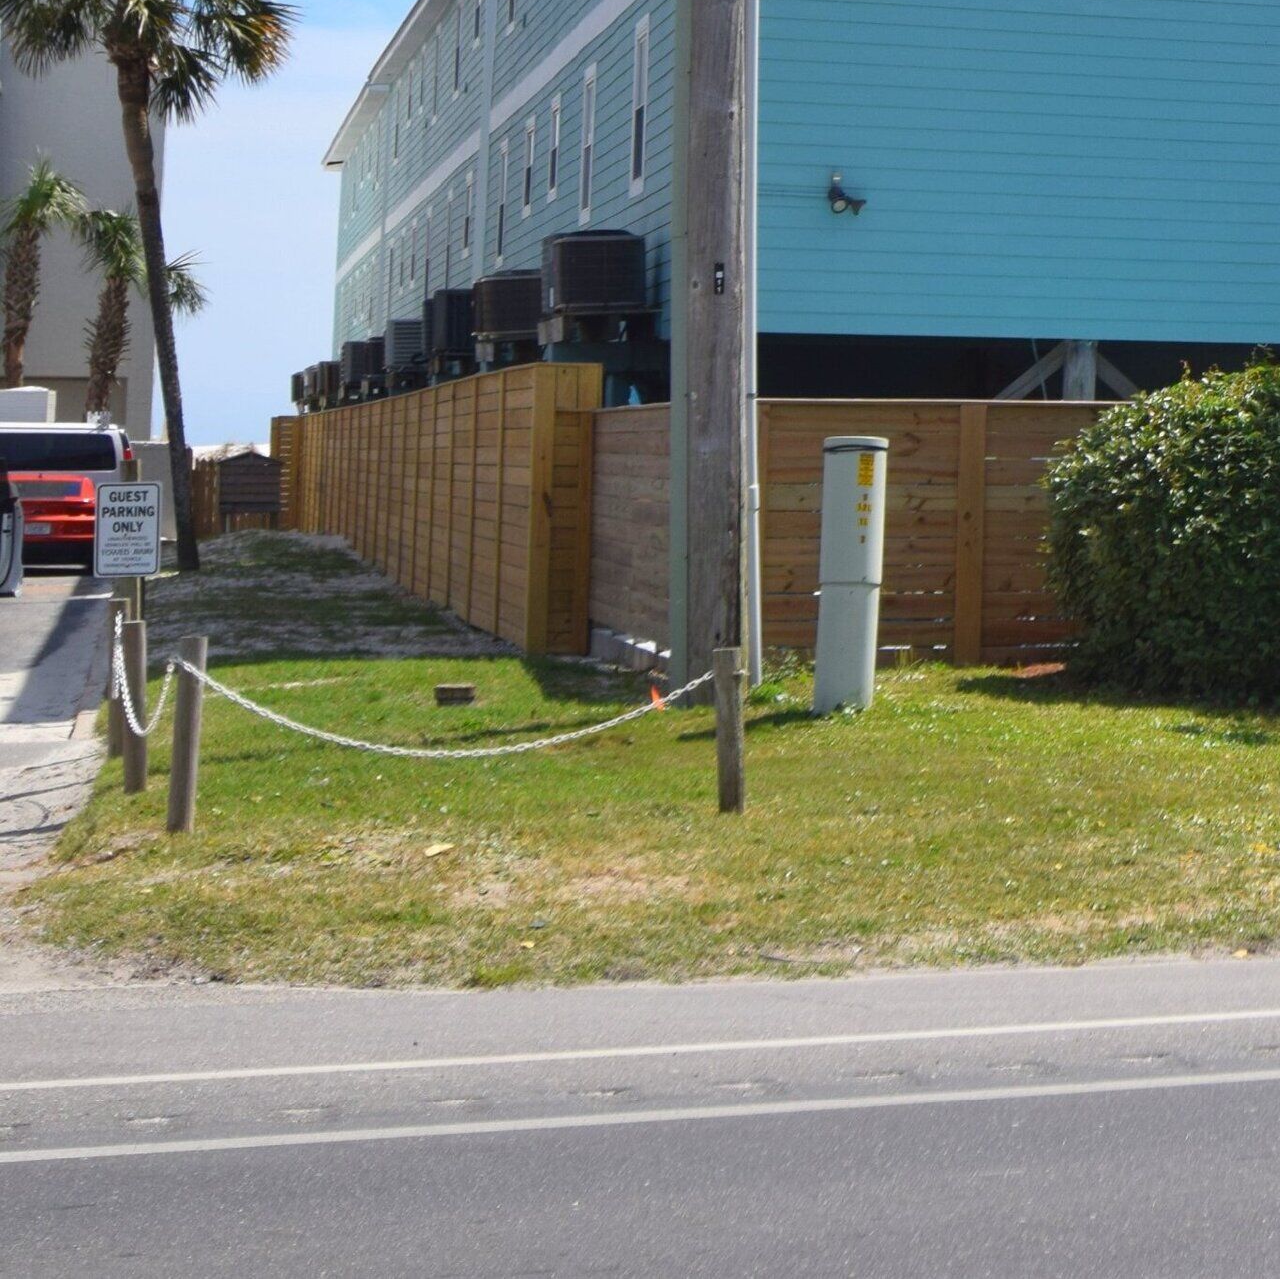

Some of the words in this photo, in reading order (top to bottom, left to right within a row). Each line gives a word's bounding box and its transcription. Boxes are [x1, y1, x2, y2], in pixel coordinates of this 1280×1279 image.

[109, 491, 148, 502] GUEST
[102, 506, 155, 518] PARKING
[112, 521, 143, 533] ONLY
